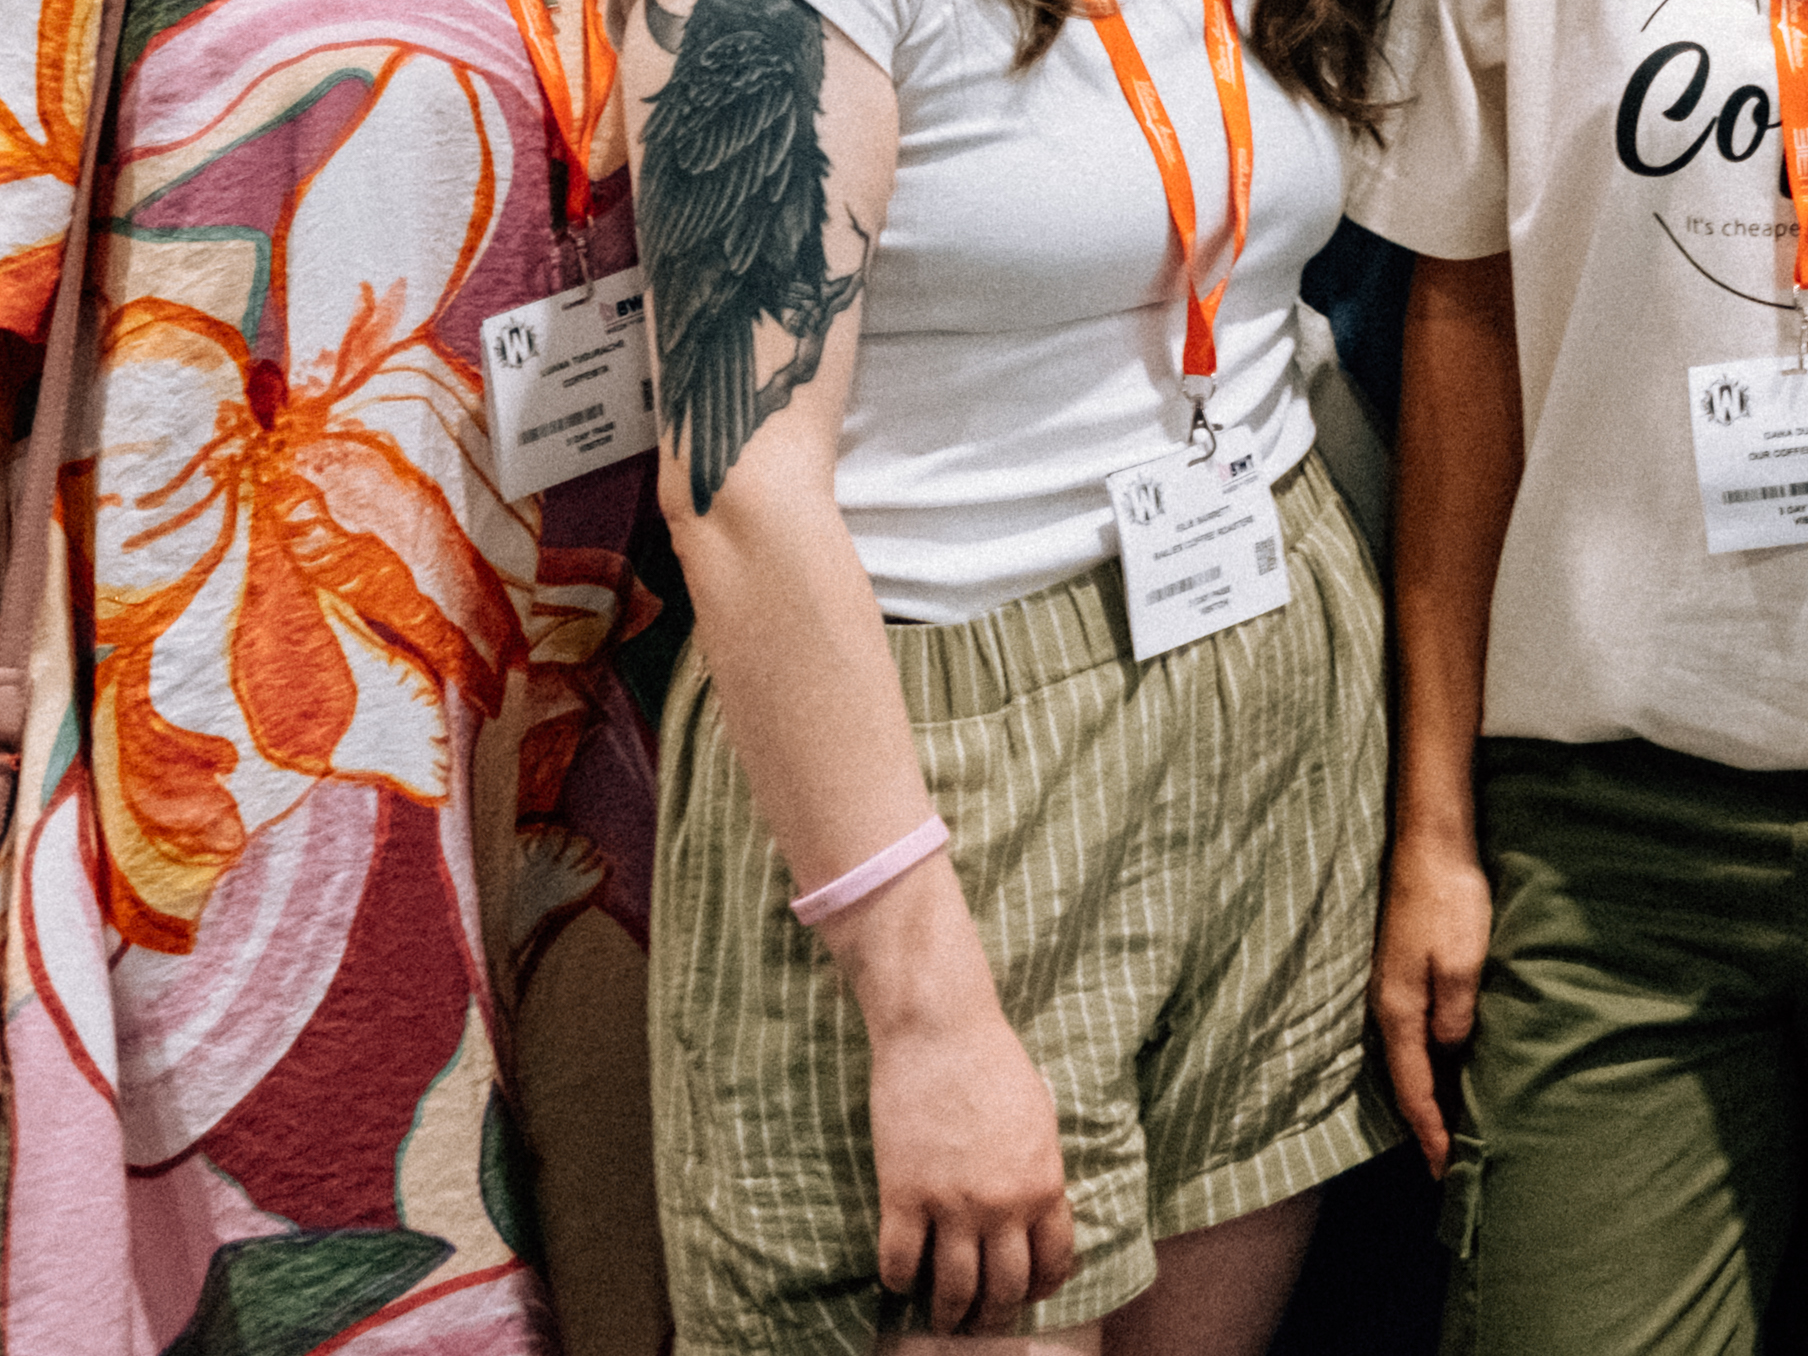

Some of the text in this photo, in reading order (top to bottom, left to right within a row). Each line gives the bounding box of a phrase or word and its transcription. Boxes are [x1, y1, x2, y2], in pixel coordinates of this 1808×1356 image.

[1686, 215, 1714, 236] It's
[1721, 219, 1800, 241] cheape
[616, 294, 645, 318] BW
